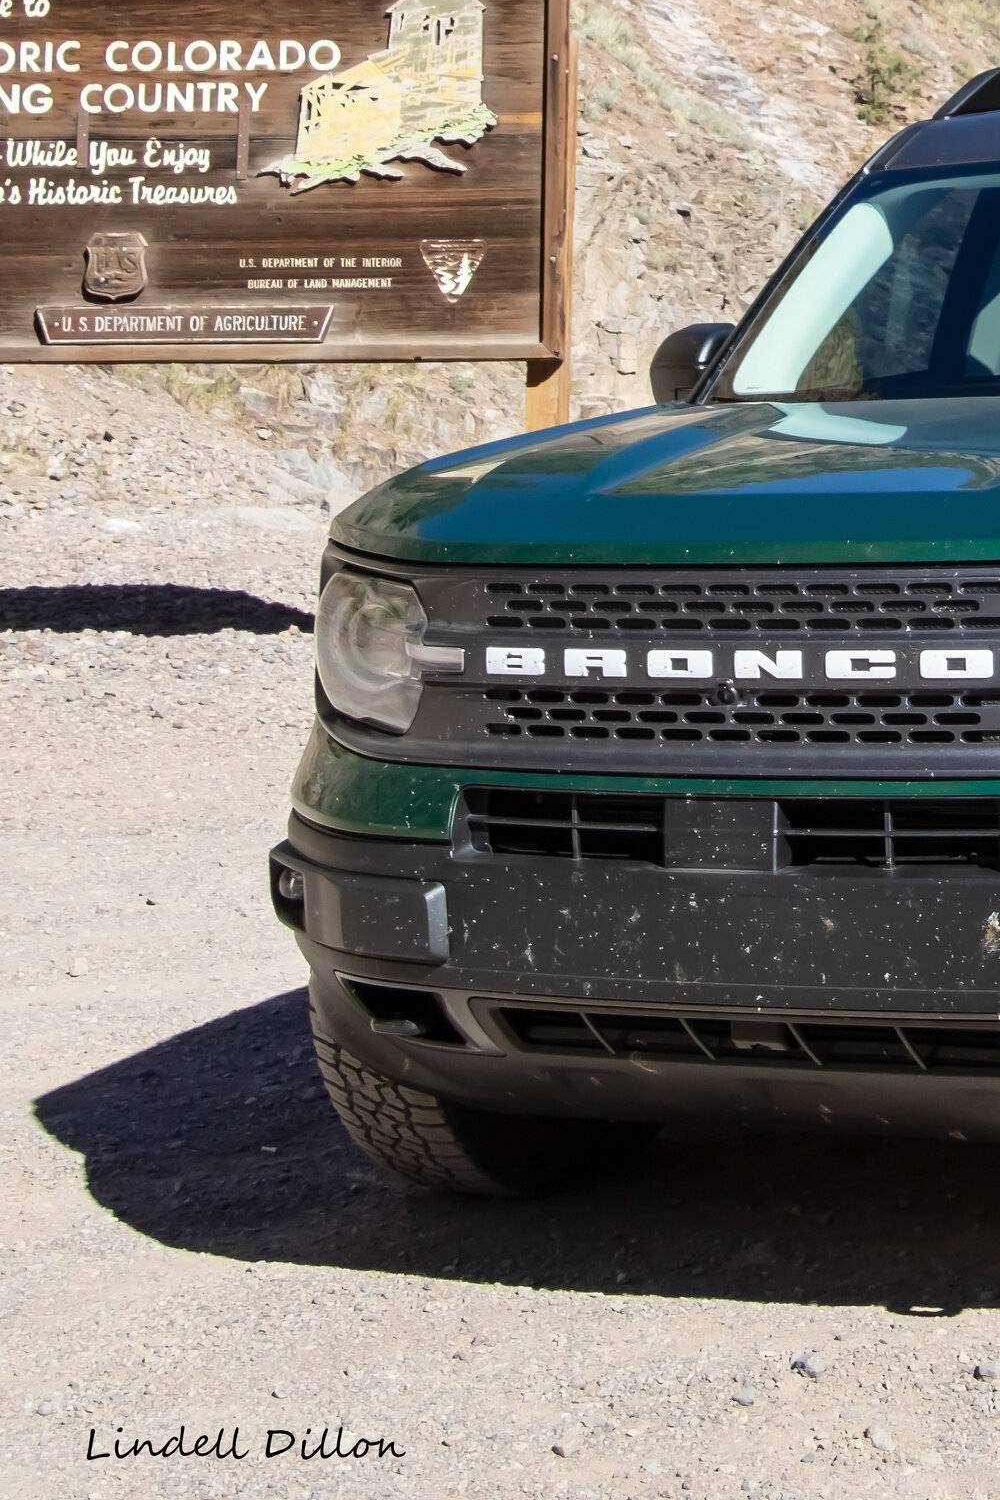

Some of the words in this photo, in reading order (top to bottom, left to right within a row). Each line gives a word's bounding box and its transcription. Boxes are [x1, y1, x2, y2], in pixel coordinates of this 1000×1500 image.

[105, 39, 342, 72] COLORADO
[80, 82, 268, 114] COUNTRY
[7, 138, 78, 167] While
[89, 141, 137, 175] You
[143, 137, 210, 173] Enjoy
[28, 177, 123, 205] Historic
[128, 176, 238, 205] Treasures
[239, 258, 257, 269] U.S.
[262, 257, 319, 268] DEPARTMENT
[323, 257, 336, 268] OF
[340, 257, 357, 268] THE
[362, 257, 402, 268] INTERIOR
[247, 278, 283, 289] BUREAU
[287, 278, 299, 289] OF
[304, 278, 327, 289] LAND
[331, 277, 393, 289] MANAGEMENT
[95, 315, 184, 332] DEPARTMENT
[189, 315, 208, 331] OF
[213, 315, 307, 331] AGRICULTURE
[485, 647, 994, 679] BRONCO
